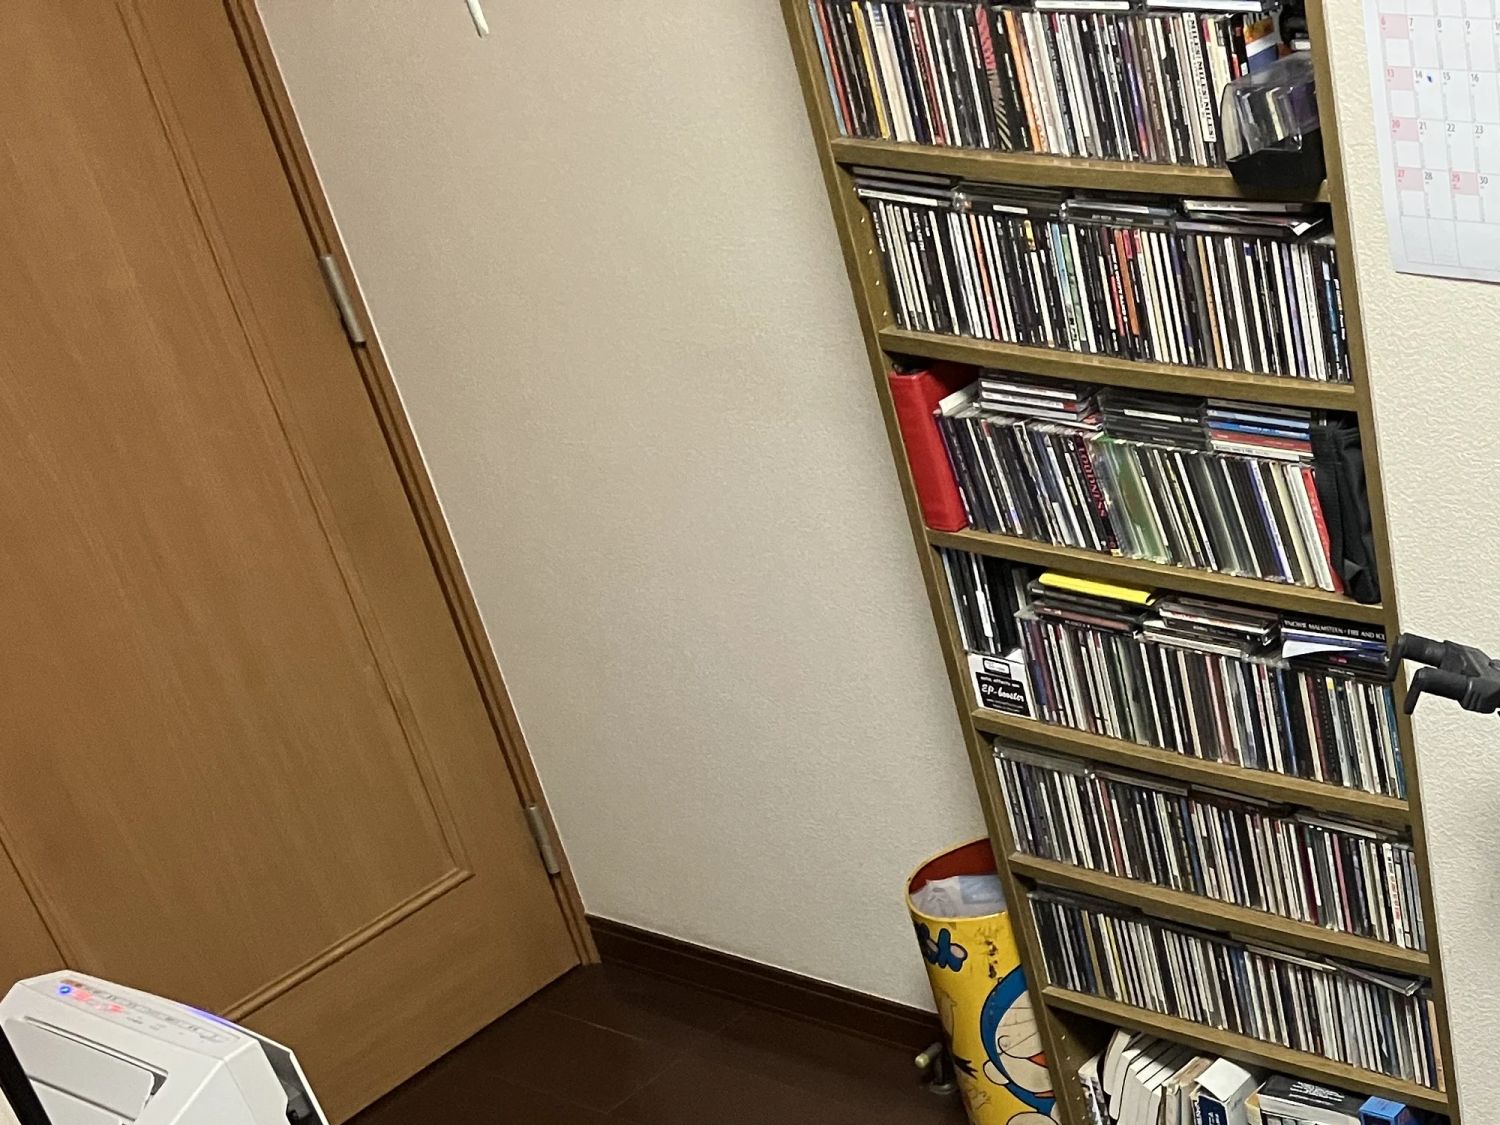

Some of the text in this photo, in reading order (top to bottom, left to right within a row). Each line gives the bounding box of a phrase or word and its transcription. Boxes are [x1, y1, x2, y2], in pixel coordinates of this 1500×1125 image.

[1409, 18, 1413, 26] 7
[1437, 20, 1442, 28] 8
[1466, 21, 1470, 30] 9
[1387, 69, 1394, 78] 13
[1415, 70, 1422, 80] 14
[1442, 72, 1450, 81] 15
[1471, 74, 1479, 83] 16
[1419, 121, 1427, 130] 21
[1447, 123, 1456, 132] 22
[1475, 125, 1484, 134] 23
[1424, 171, 1433, 181] 28
[1479, 175, 1488, 185] 30
[1076, 446, 1108, 519] LOUDNESS
[1308, 624, 1344, 634] MALMSTEEN
